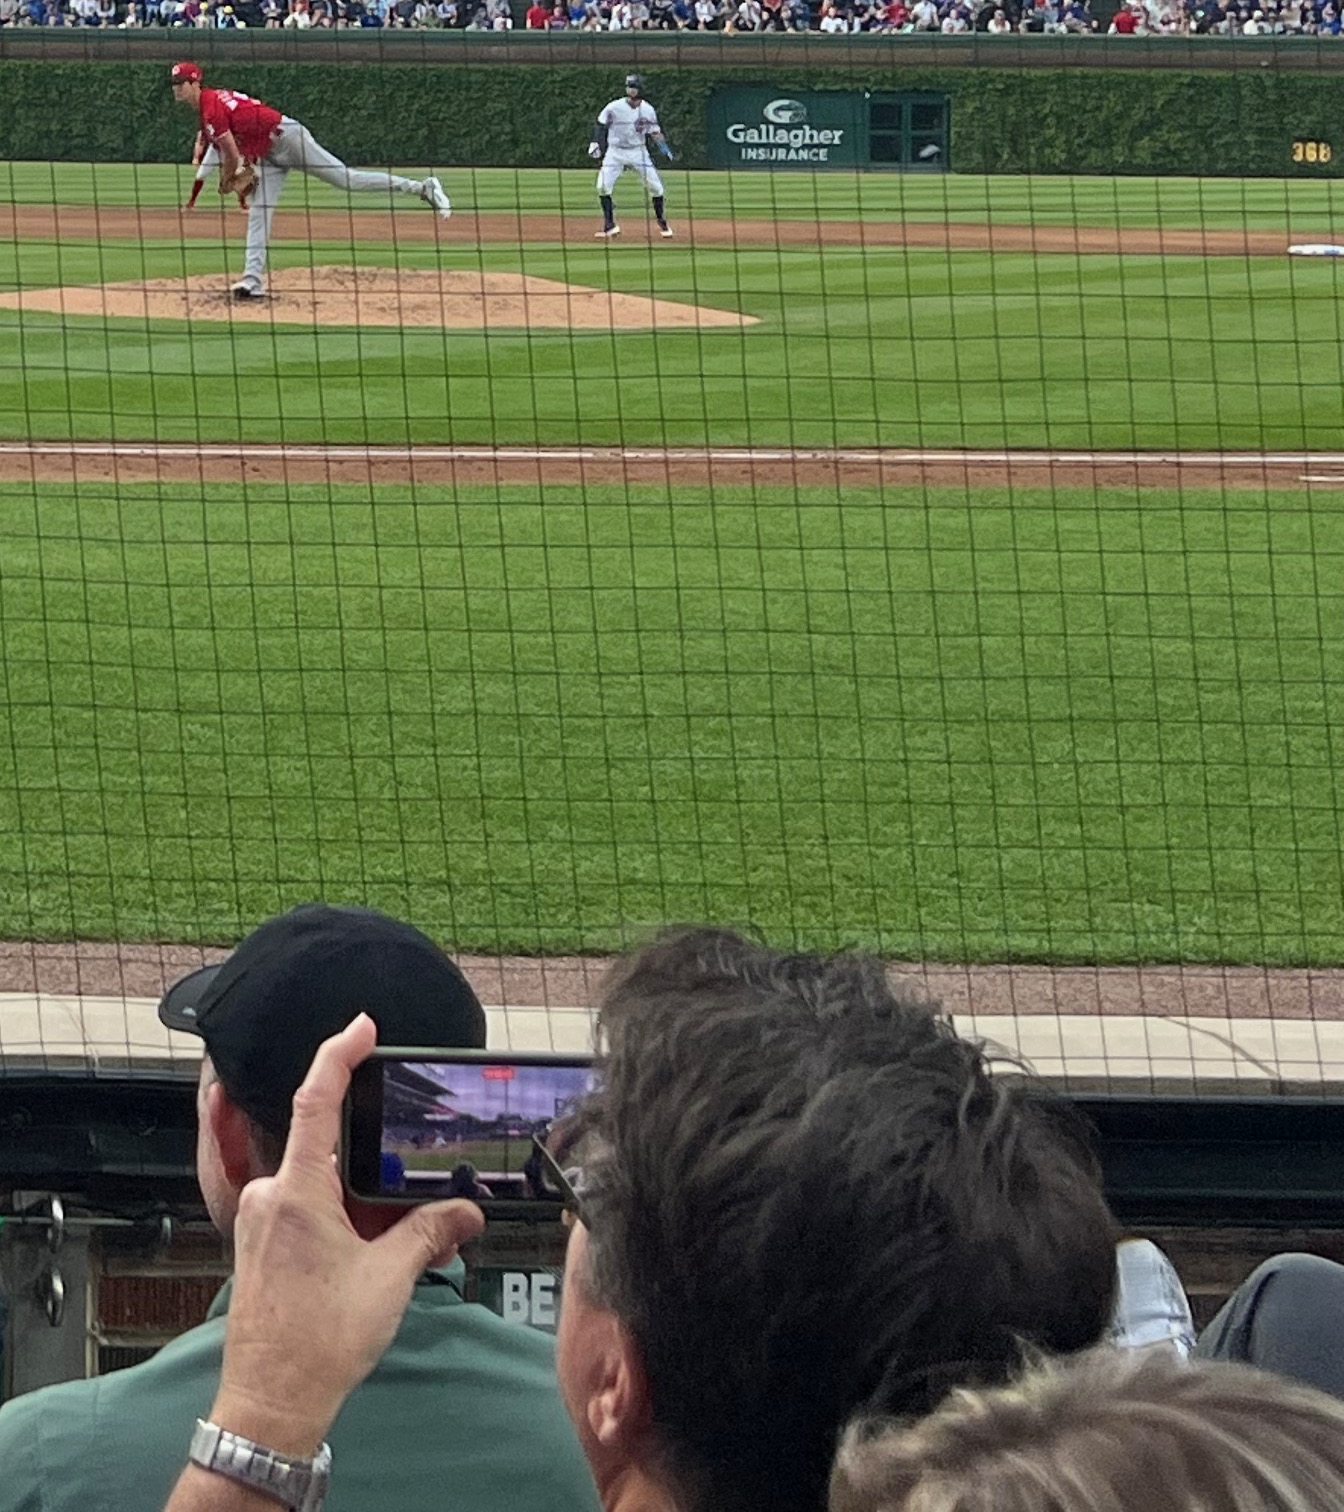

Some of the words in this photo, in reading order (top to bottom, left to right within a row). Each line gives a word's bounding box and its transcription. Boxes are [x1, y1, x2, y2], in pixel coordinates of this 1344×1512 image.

[726, 122, 844, 149] Gallagher
[740, 147, 829, 162] INSURANCE
[1292, 141, 1332, 163] 368
